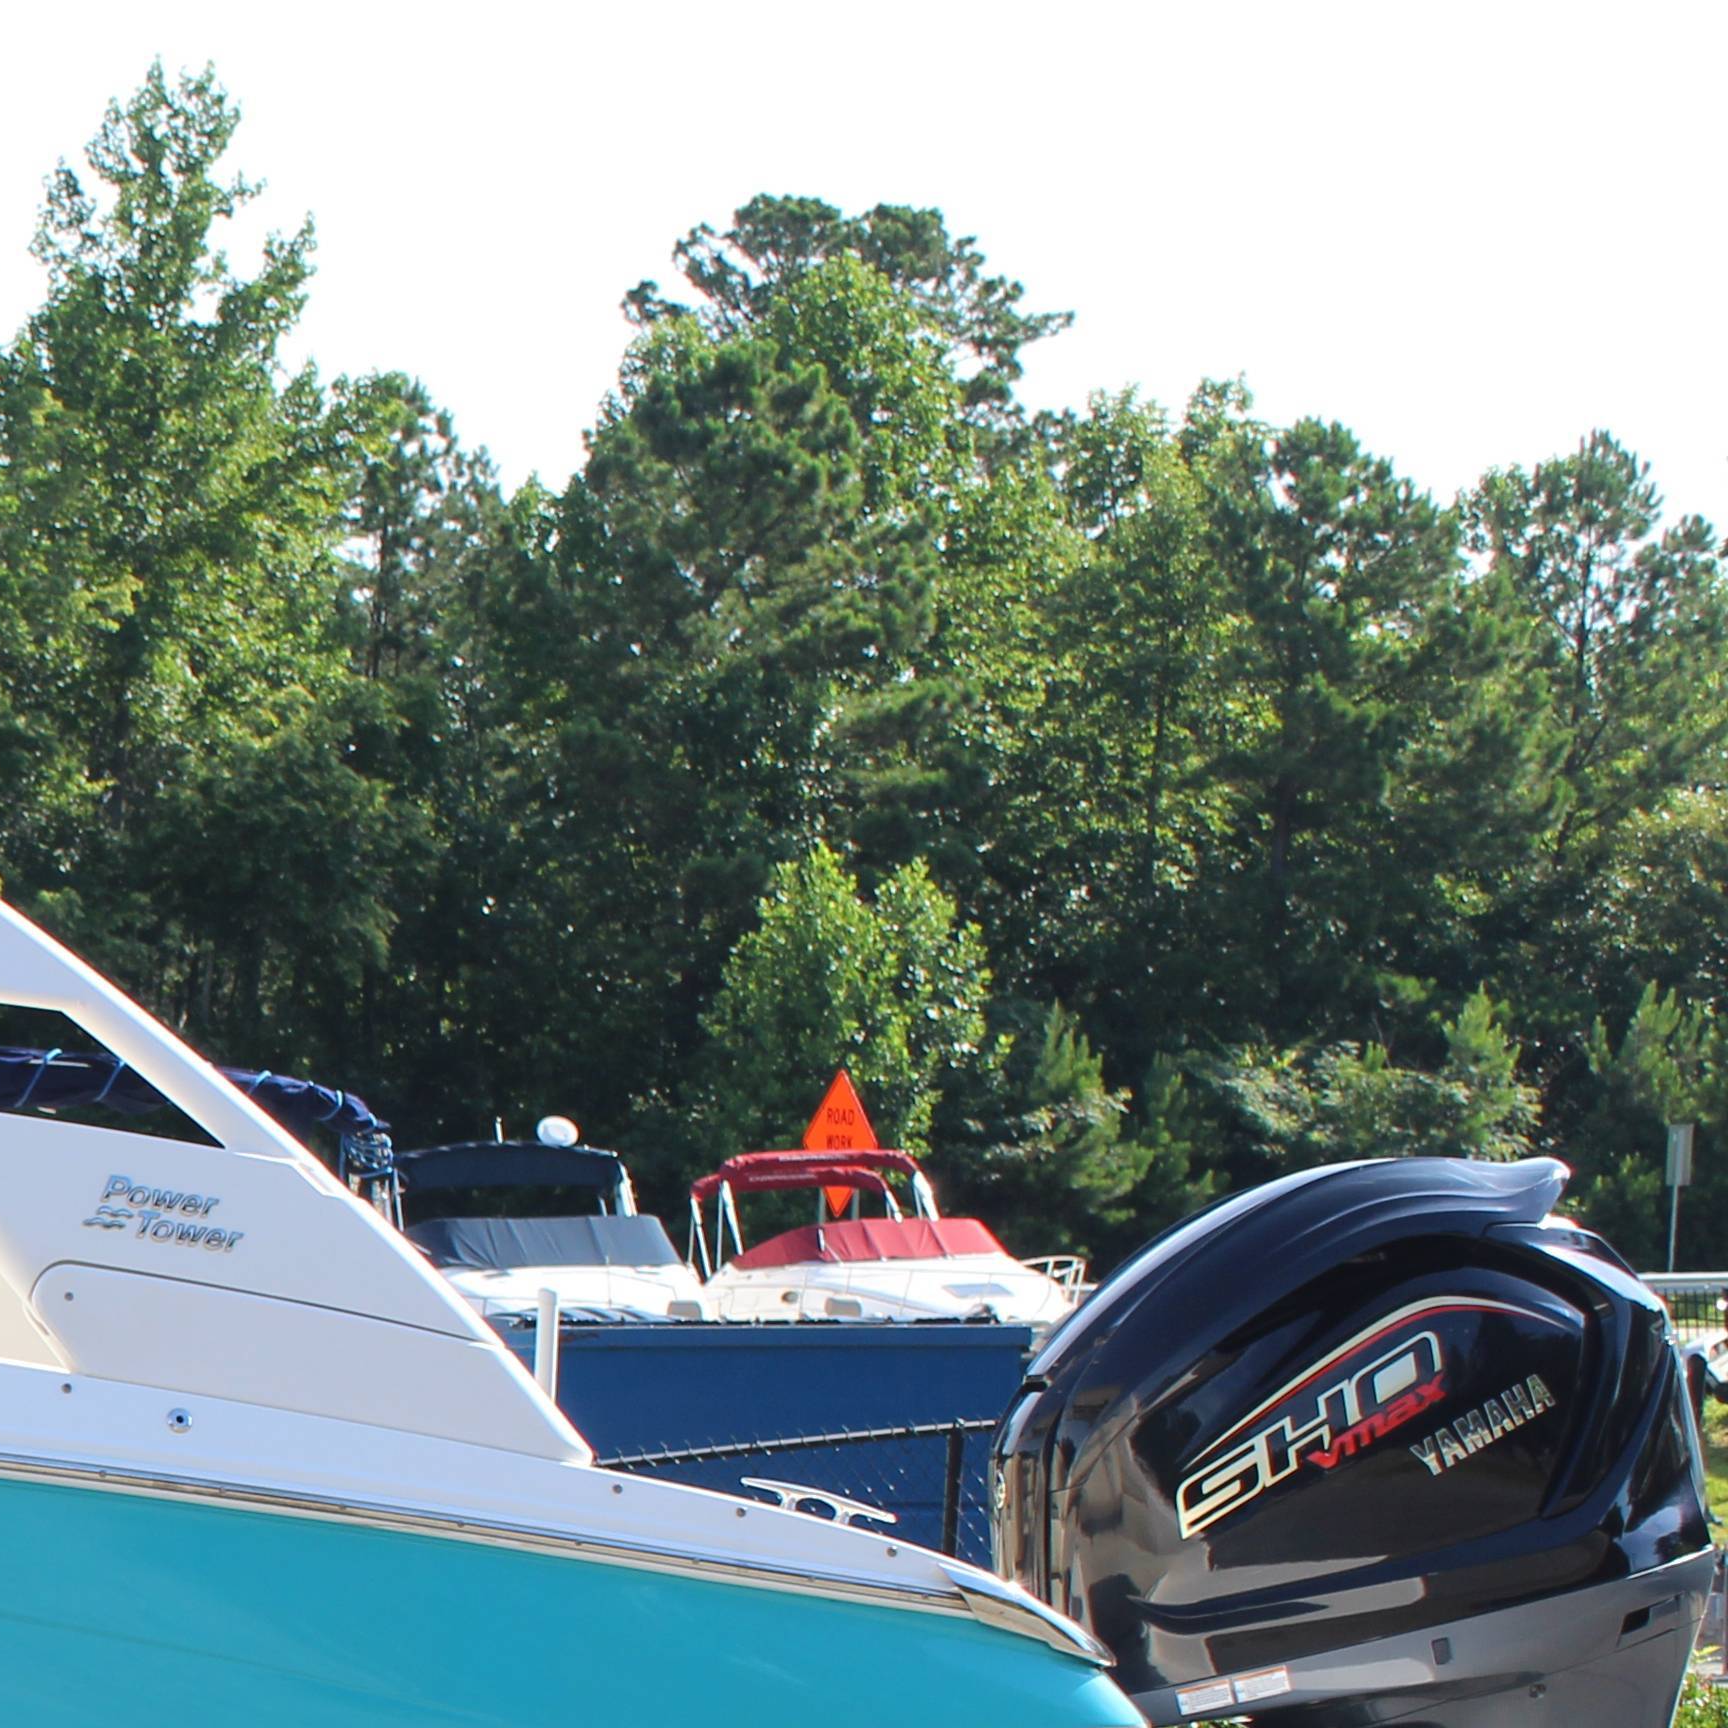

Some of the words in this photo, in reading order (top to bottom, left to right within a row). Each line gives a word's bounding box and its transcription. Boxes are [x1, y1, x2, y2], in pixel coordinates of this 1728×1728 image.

[826, 1108, 855, 1126] ROAD
[826, 1136, 853, 1150] WORK
[100, 1174, 219, 1217] Power
[136, 1210, 245, 1252] Tower
[1176, 1330, 1442, 1540] SHO
[1410, 1373, 1557, 1477] YAMAHA
